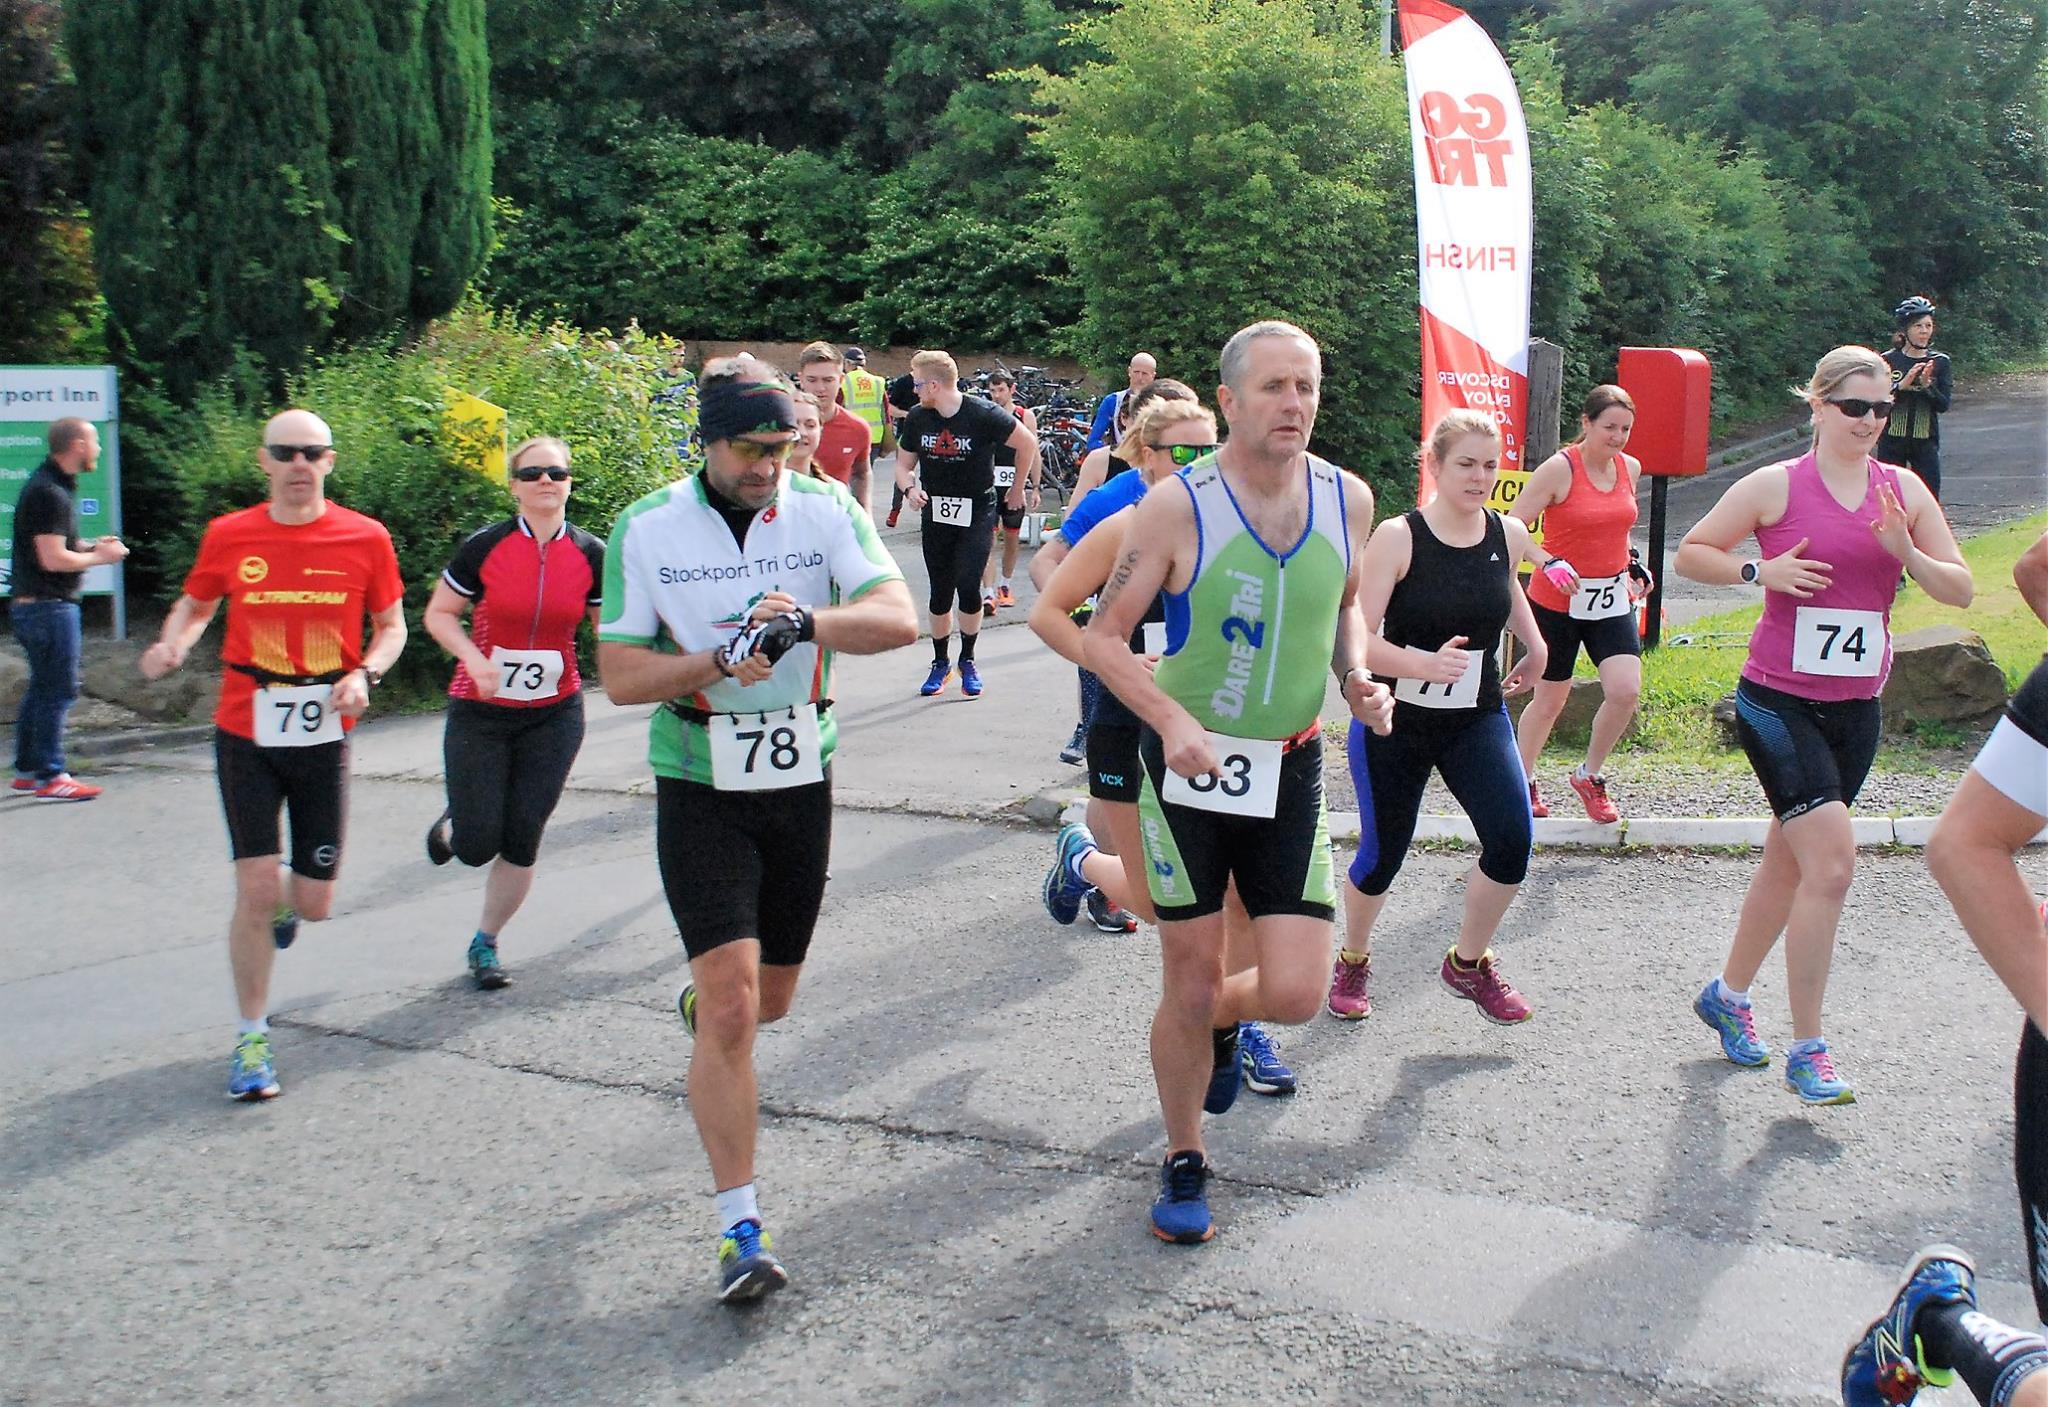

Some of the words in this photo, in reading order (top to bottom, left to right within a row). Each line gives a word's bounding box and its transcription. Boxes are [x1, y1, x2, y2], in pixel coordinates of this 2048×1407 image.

[0, 389, 53, 406] port
[64, 387, 100, 401] Inn
[921, 434, 972, 450] REOK
[940, 503, 962, 519] 87
[659, 563, 751, 584] Stockport
[754, 556, 779, 575] Tri
[785, 550, 824, 570] Club
[1584, 585, 1615, 611] 75
[1816, 624, 1866, 662] 74
[503, 662, 545, 690] 73
[275, 700, 323, 733] 79
[736, 727, 800, 773] 78
